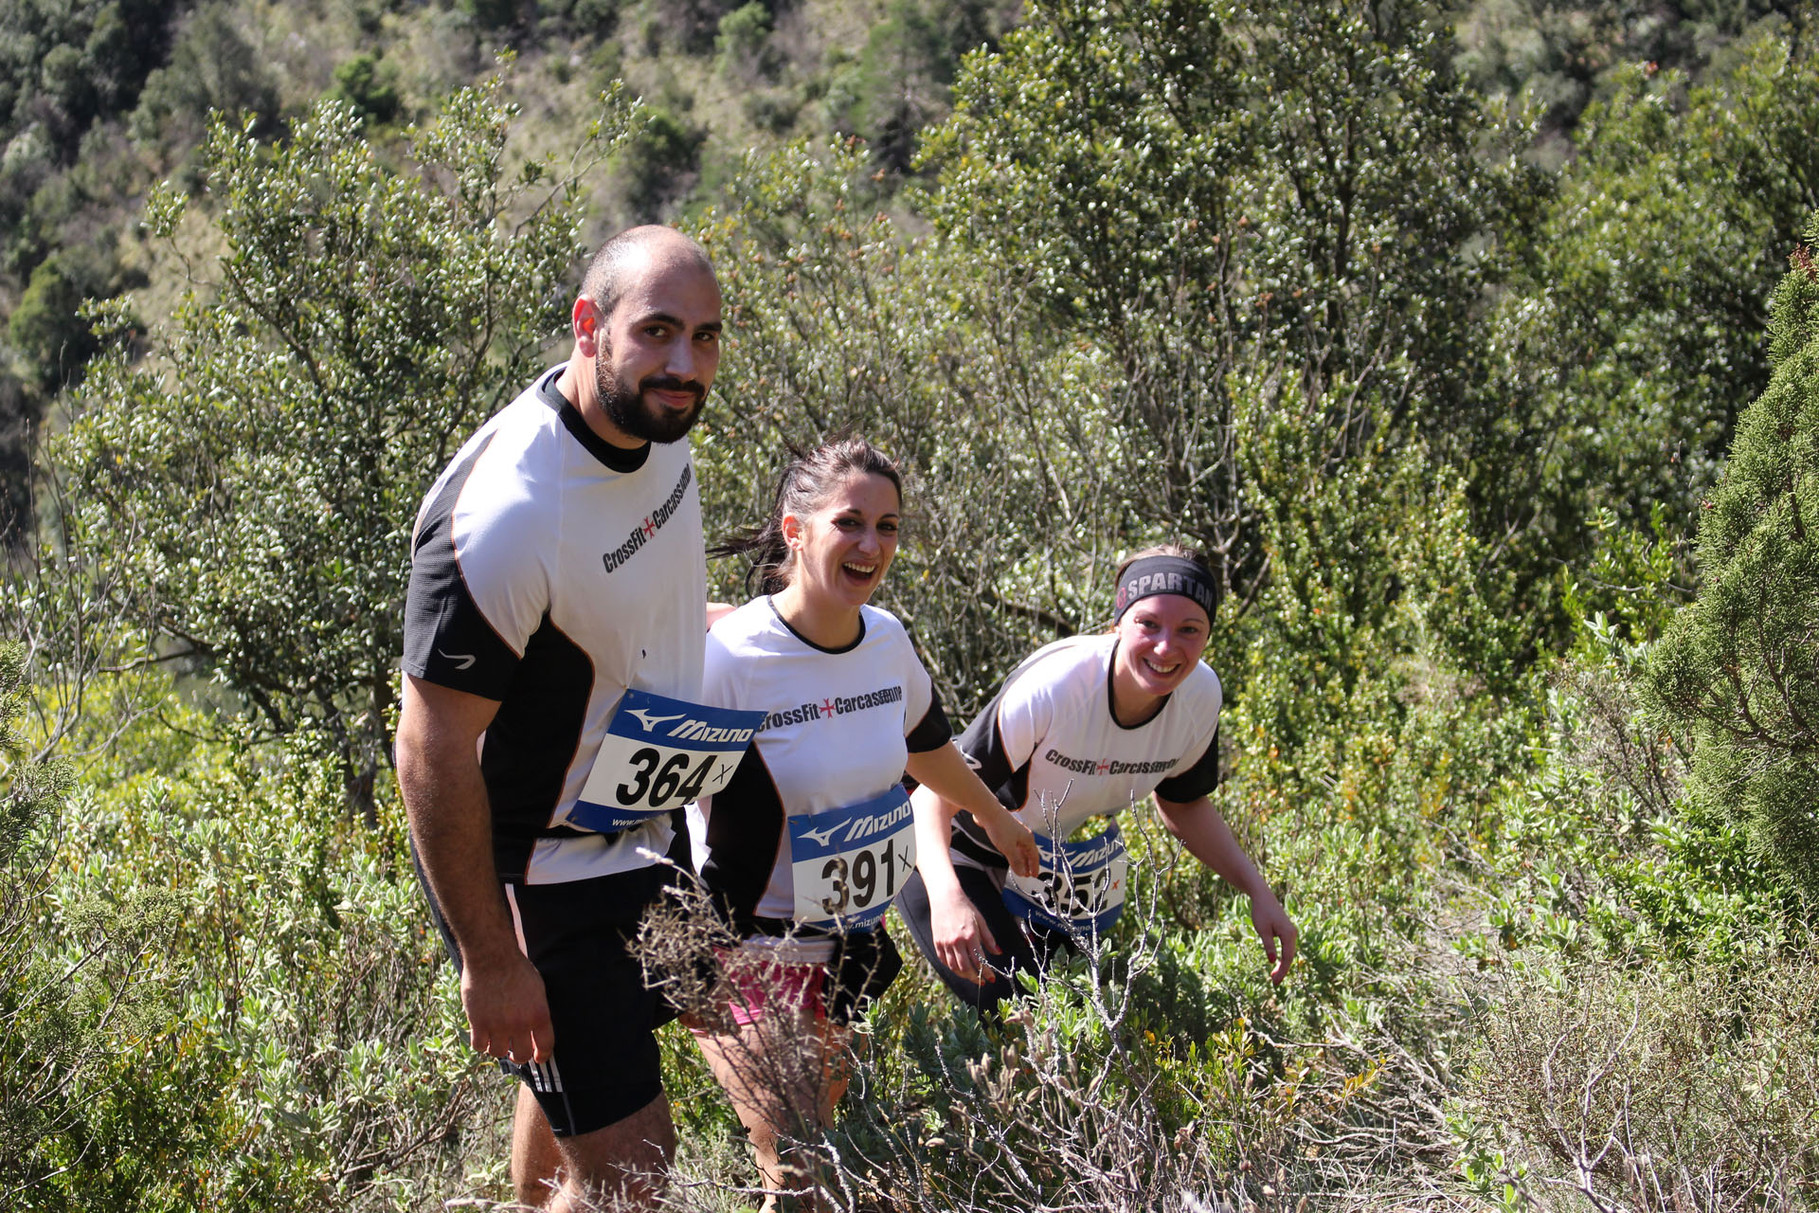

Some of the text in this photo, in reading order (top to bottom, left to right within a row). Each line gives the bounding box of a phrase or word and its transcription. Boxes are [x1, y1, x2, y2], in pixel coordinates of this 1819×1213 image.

[602, 526, 647, 574] CrossFit
[1128, 572, 1214, 611] SPARTAN
[615, 747, 718, 807] 364
[821, 838, 895, 915] 391
[1030, 867, 1111, 917] 352
